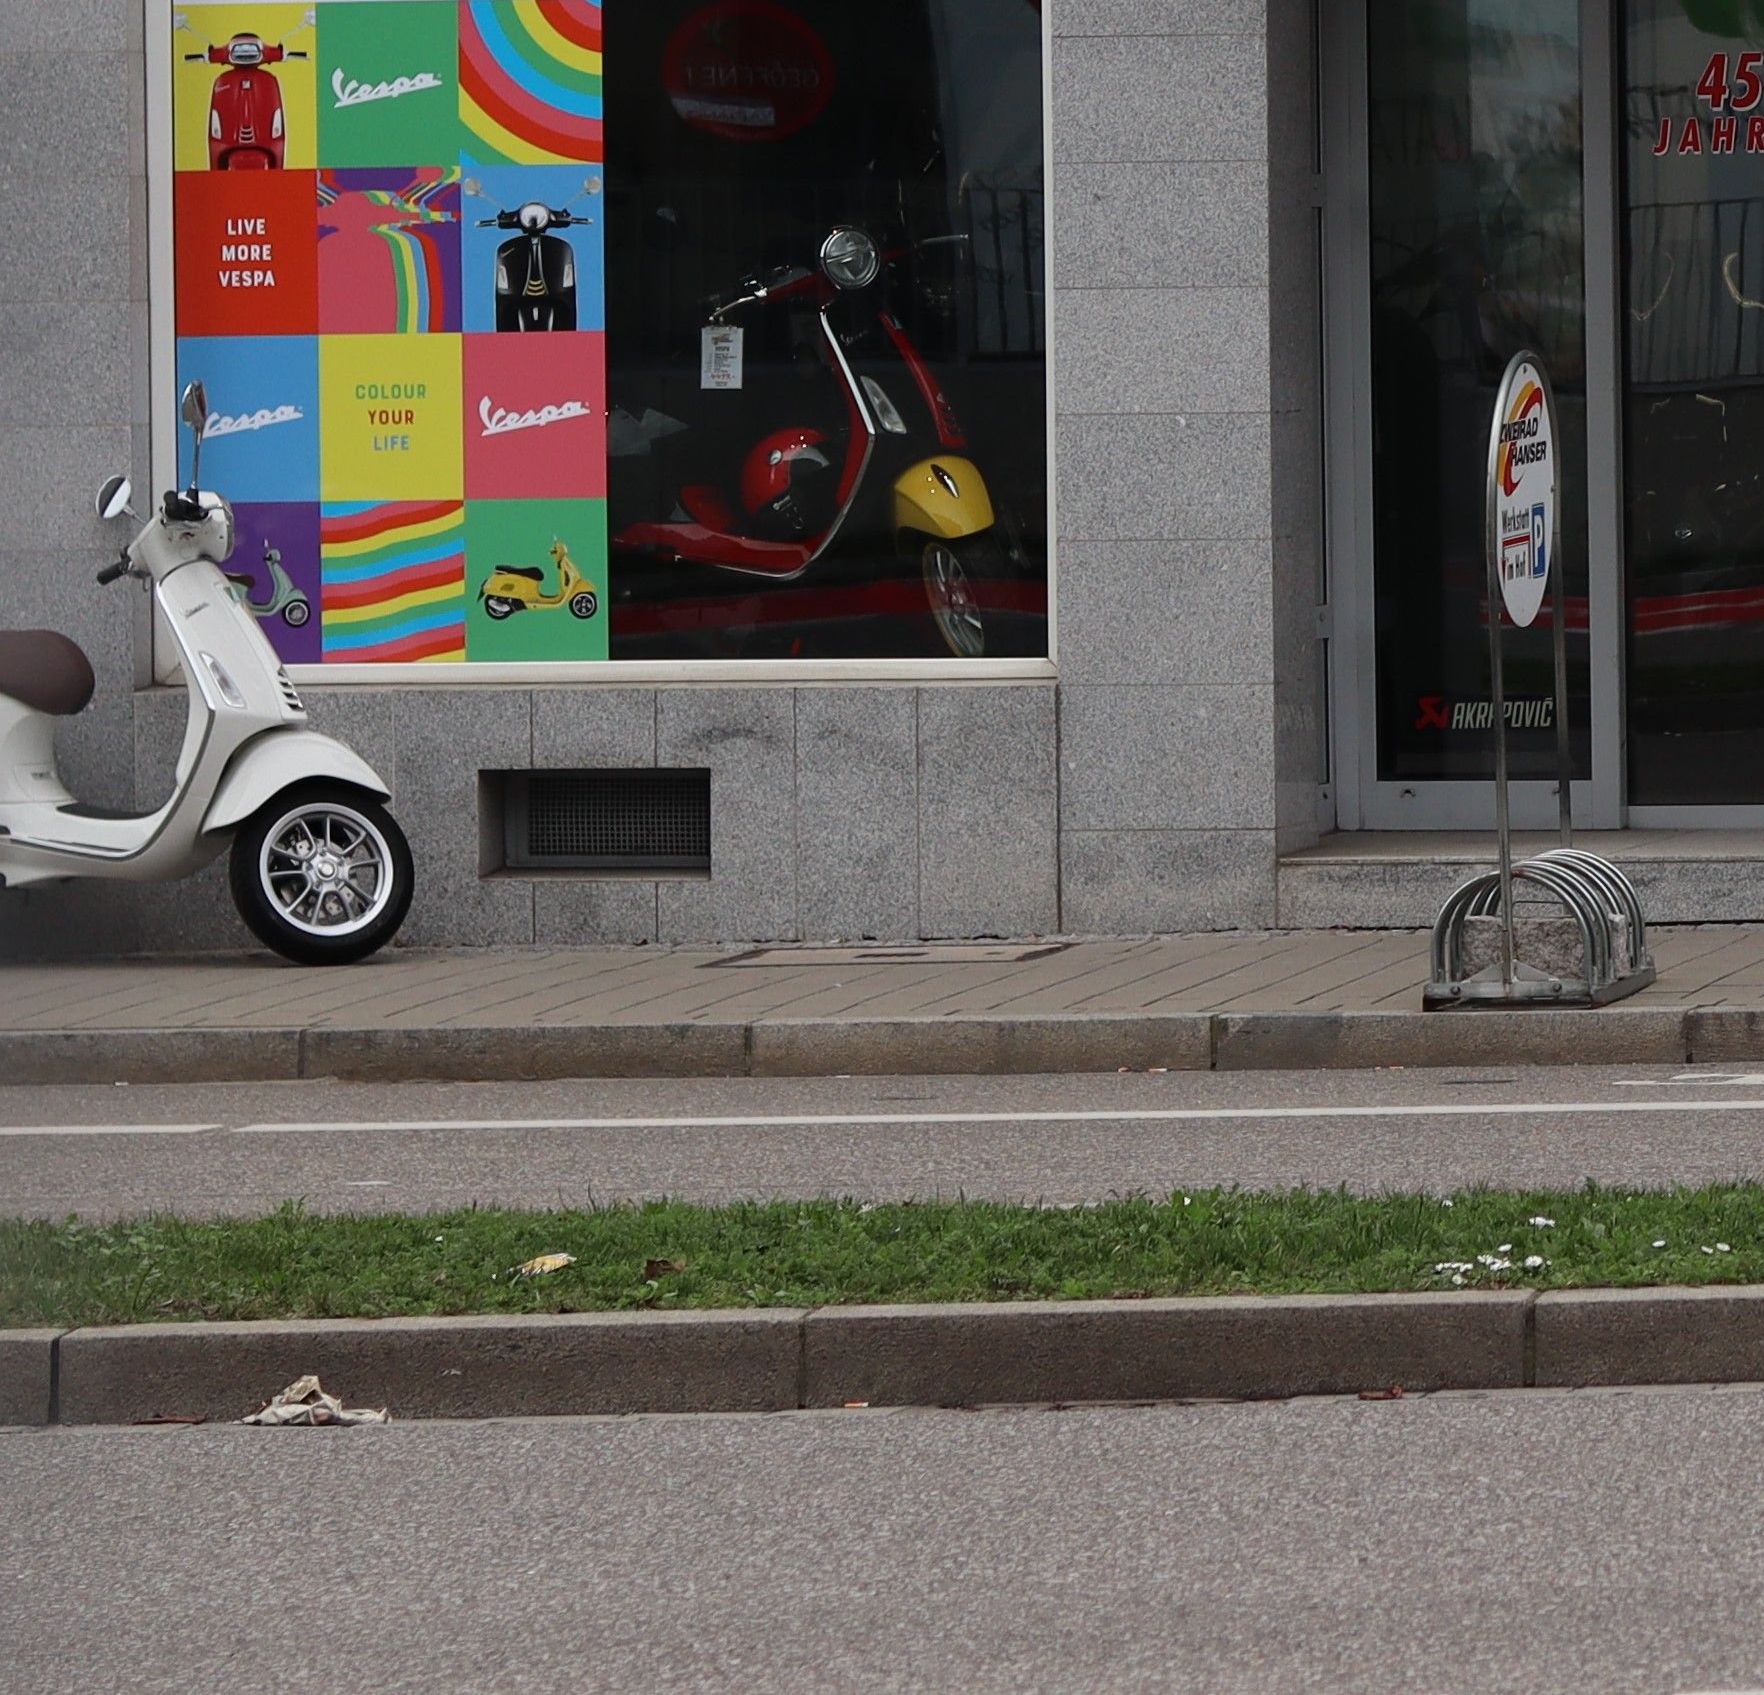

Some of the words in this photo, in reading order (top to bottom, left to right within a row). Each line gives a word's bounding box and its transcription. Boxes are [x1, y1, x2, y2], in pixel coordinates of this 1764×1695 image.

[331, 68, 443, 108] Vespa
[1697, 52, 1764, 111] 45
[227, 218, 266, 235] LIVE
[222, 244, 272, 261] MORE
[219, 270, 275, 288] VESPA
[355, 384, 427, 400] COLOUR
[368, 409, 415, 426] YOUR
[479, 396, 591, 437] Vespa
[373, 435, 410, 451] LIFE
[1501, 504, 1530, 534] Werkstatt
